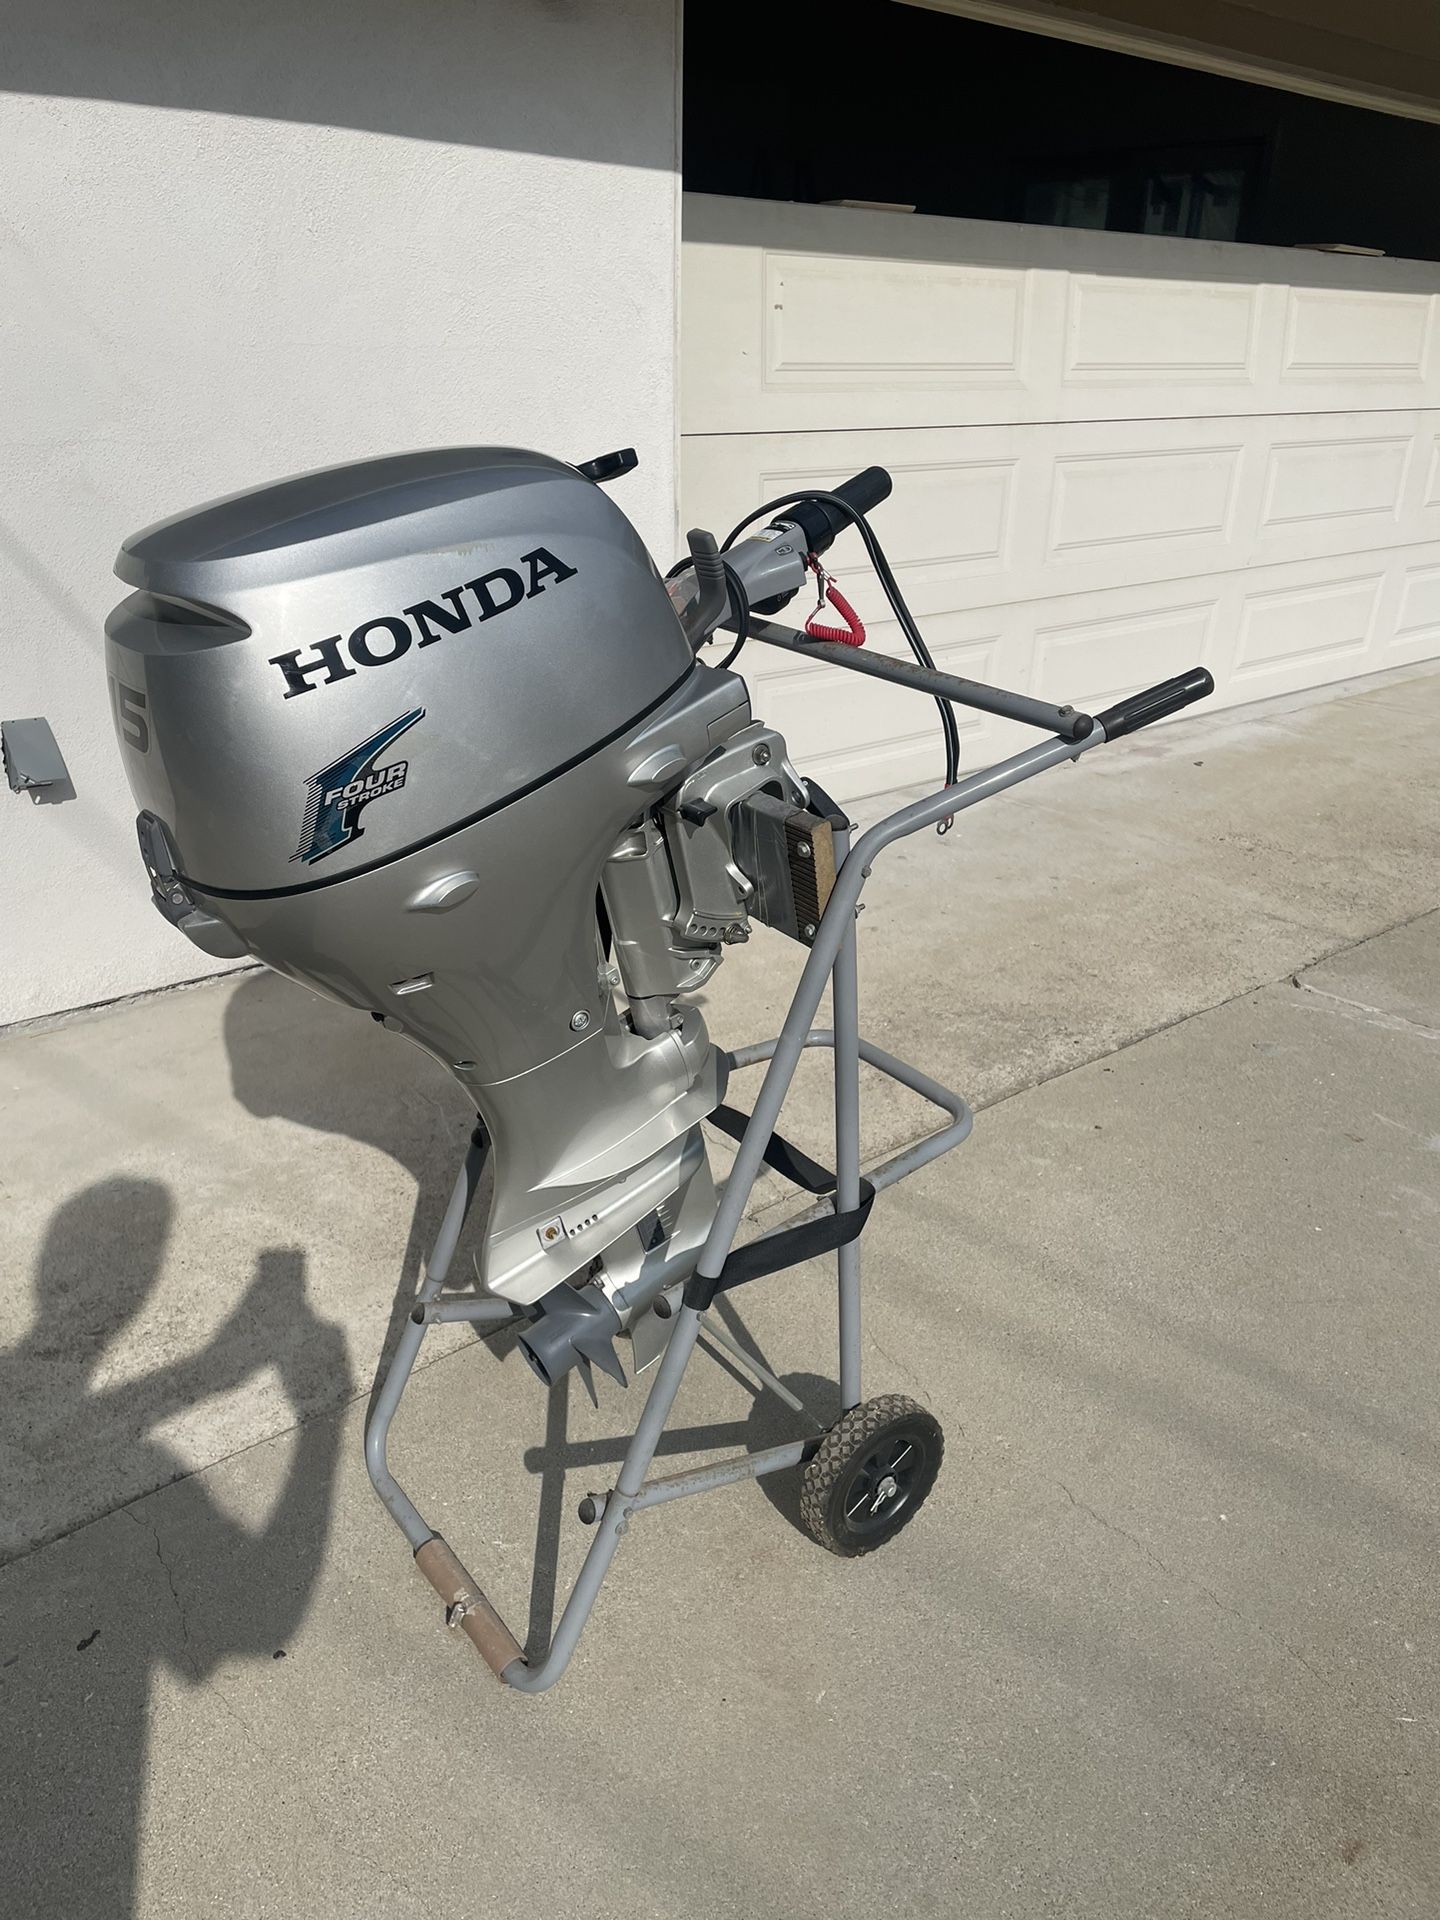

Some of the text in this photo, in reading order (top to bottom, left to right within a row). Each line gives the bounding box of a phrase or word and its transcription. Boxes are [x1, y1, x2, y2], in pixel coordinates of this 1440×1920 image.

[268, 546, 578, 700] HONDA
[324, 762, 406, 806] FOUR
[337, 777, 404, 810] STROKE
